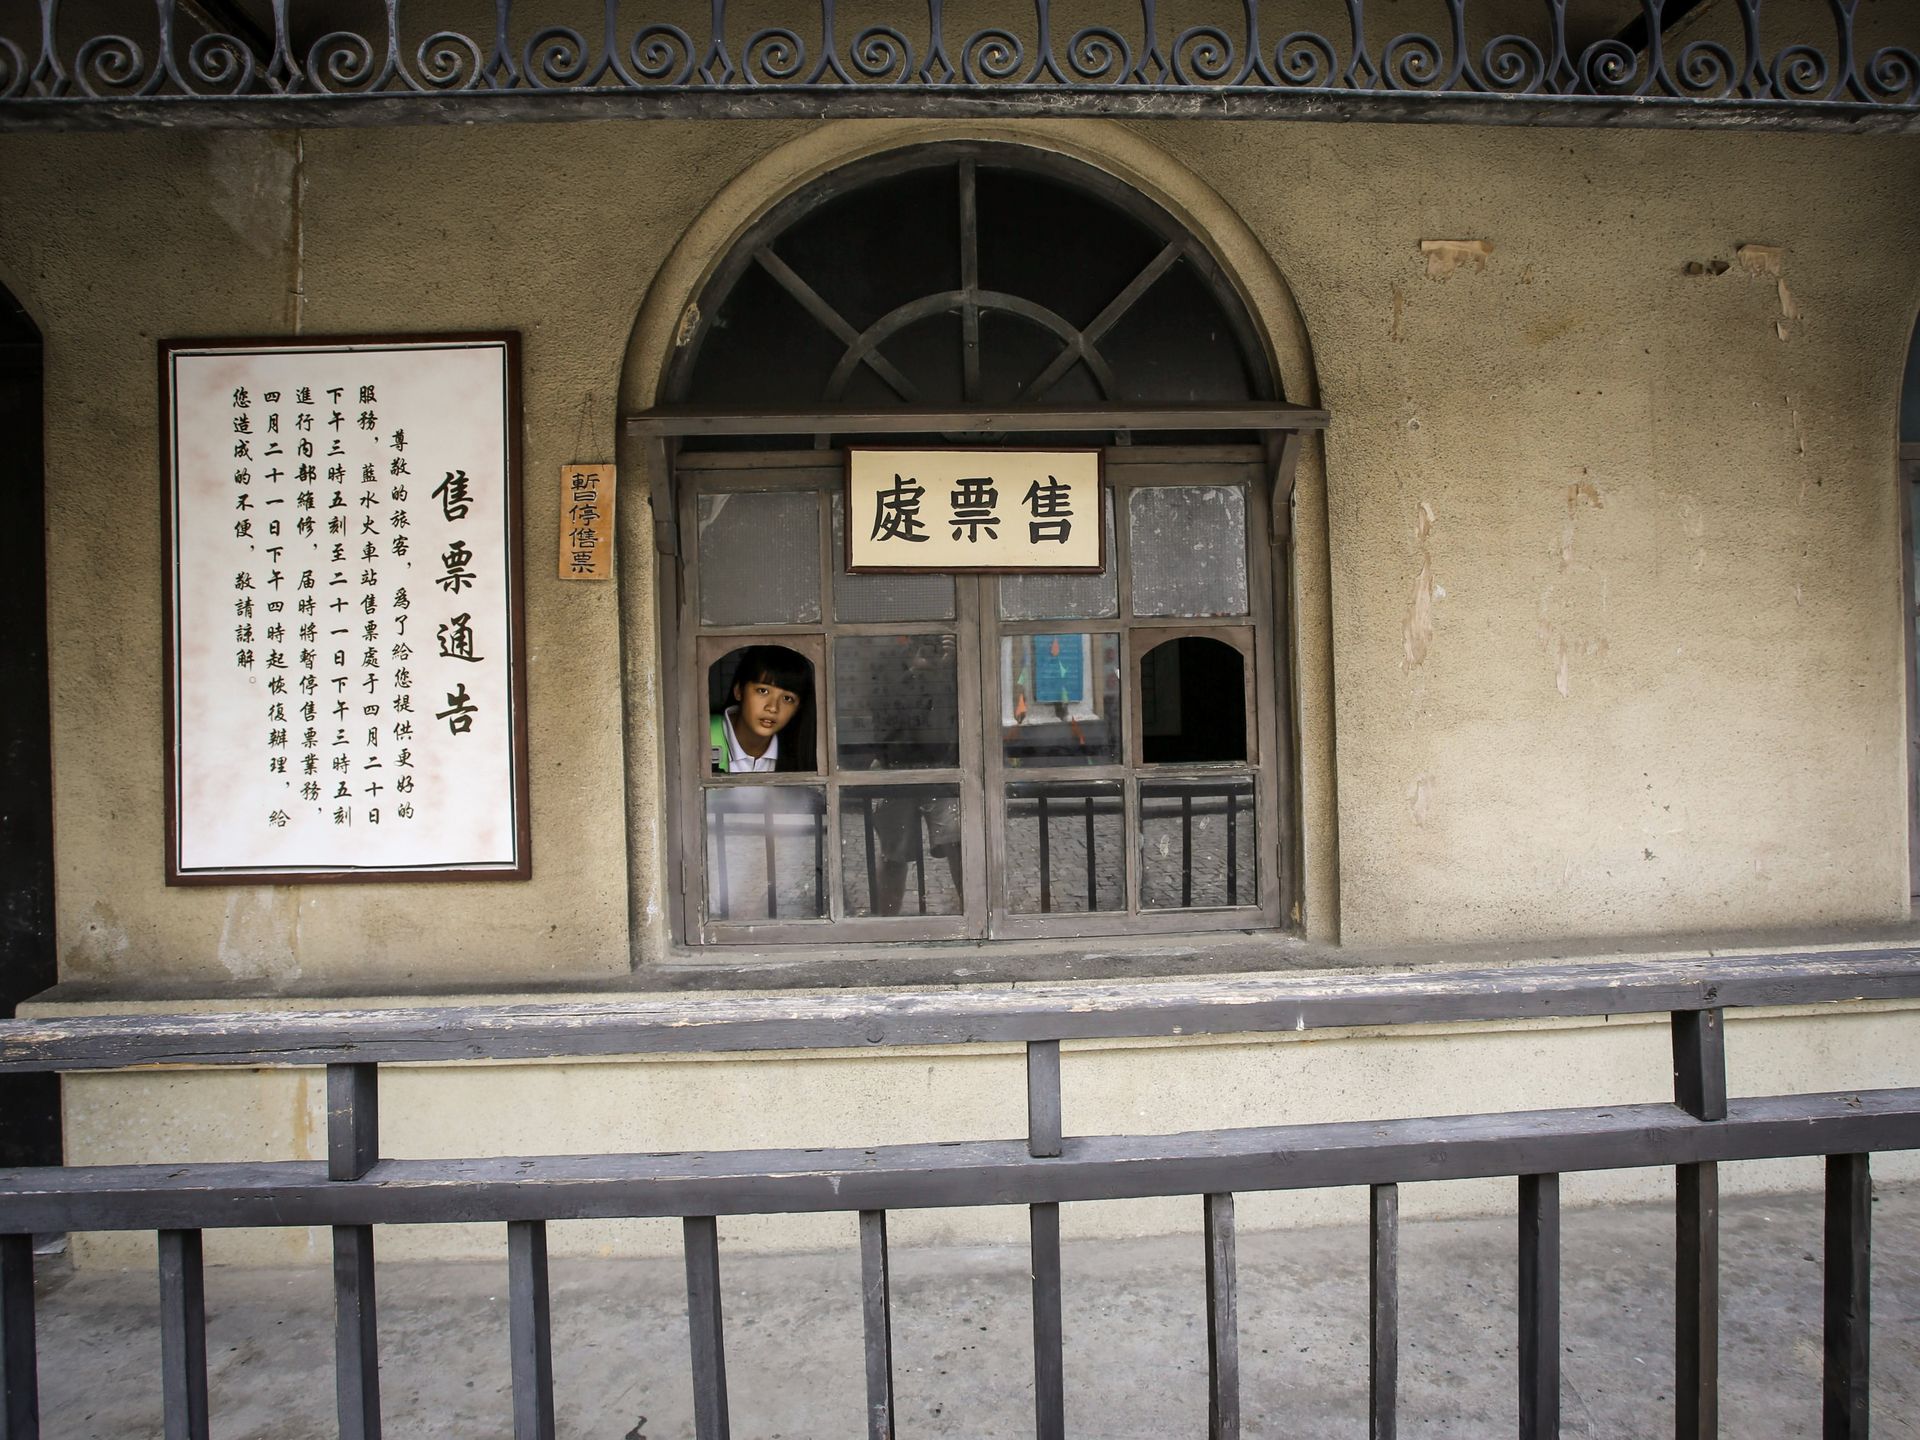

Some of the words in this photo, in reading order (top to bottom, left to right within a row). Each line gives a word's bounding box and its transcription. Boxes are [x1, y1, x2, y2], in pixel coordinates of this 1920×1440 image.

[325, 387, 353, 828] 下午三時五刻至二十一日下午三時五刻
[431, 469, 485, 736] 售票通告
[569, 473, 600, 573] 暫停售票
